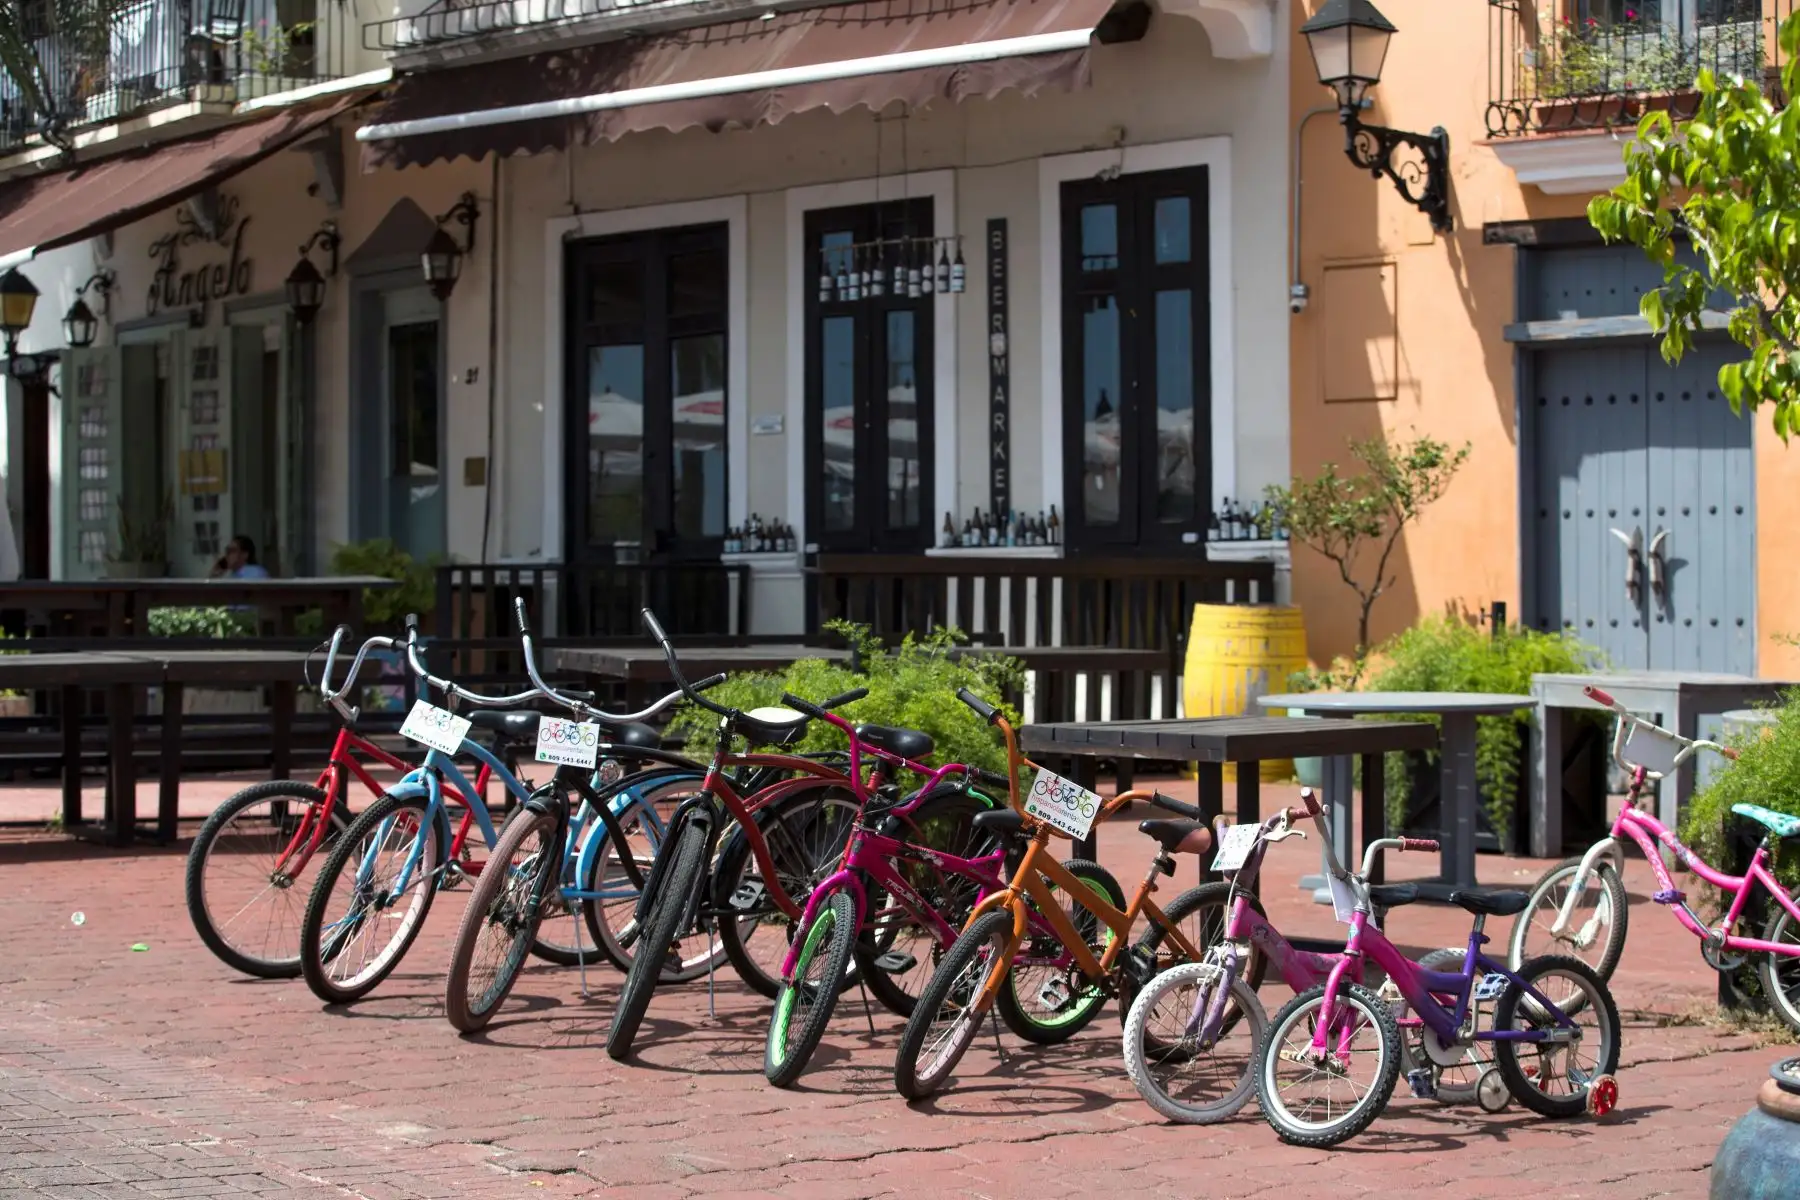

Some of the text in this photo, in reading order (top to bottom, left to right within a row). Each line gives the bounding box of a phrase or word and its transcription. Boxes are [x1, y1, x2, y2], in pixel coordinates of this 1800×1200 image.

[991, 230, 1006, 515] BEER MARKET
[1038, 810, 1084, 837] 809-543-6447
